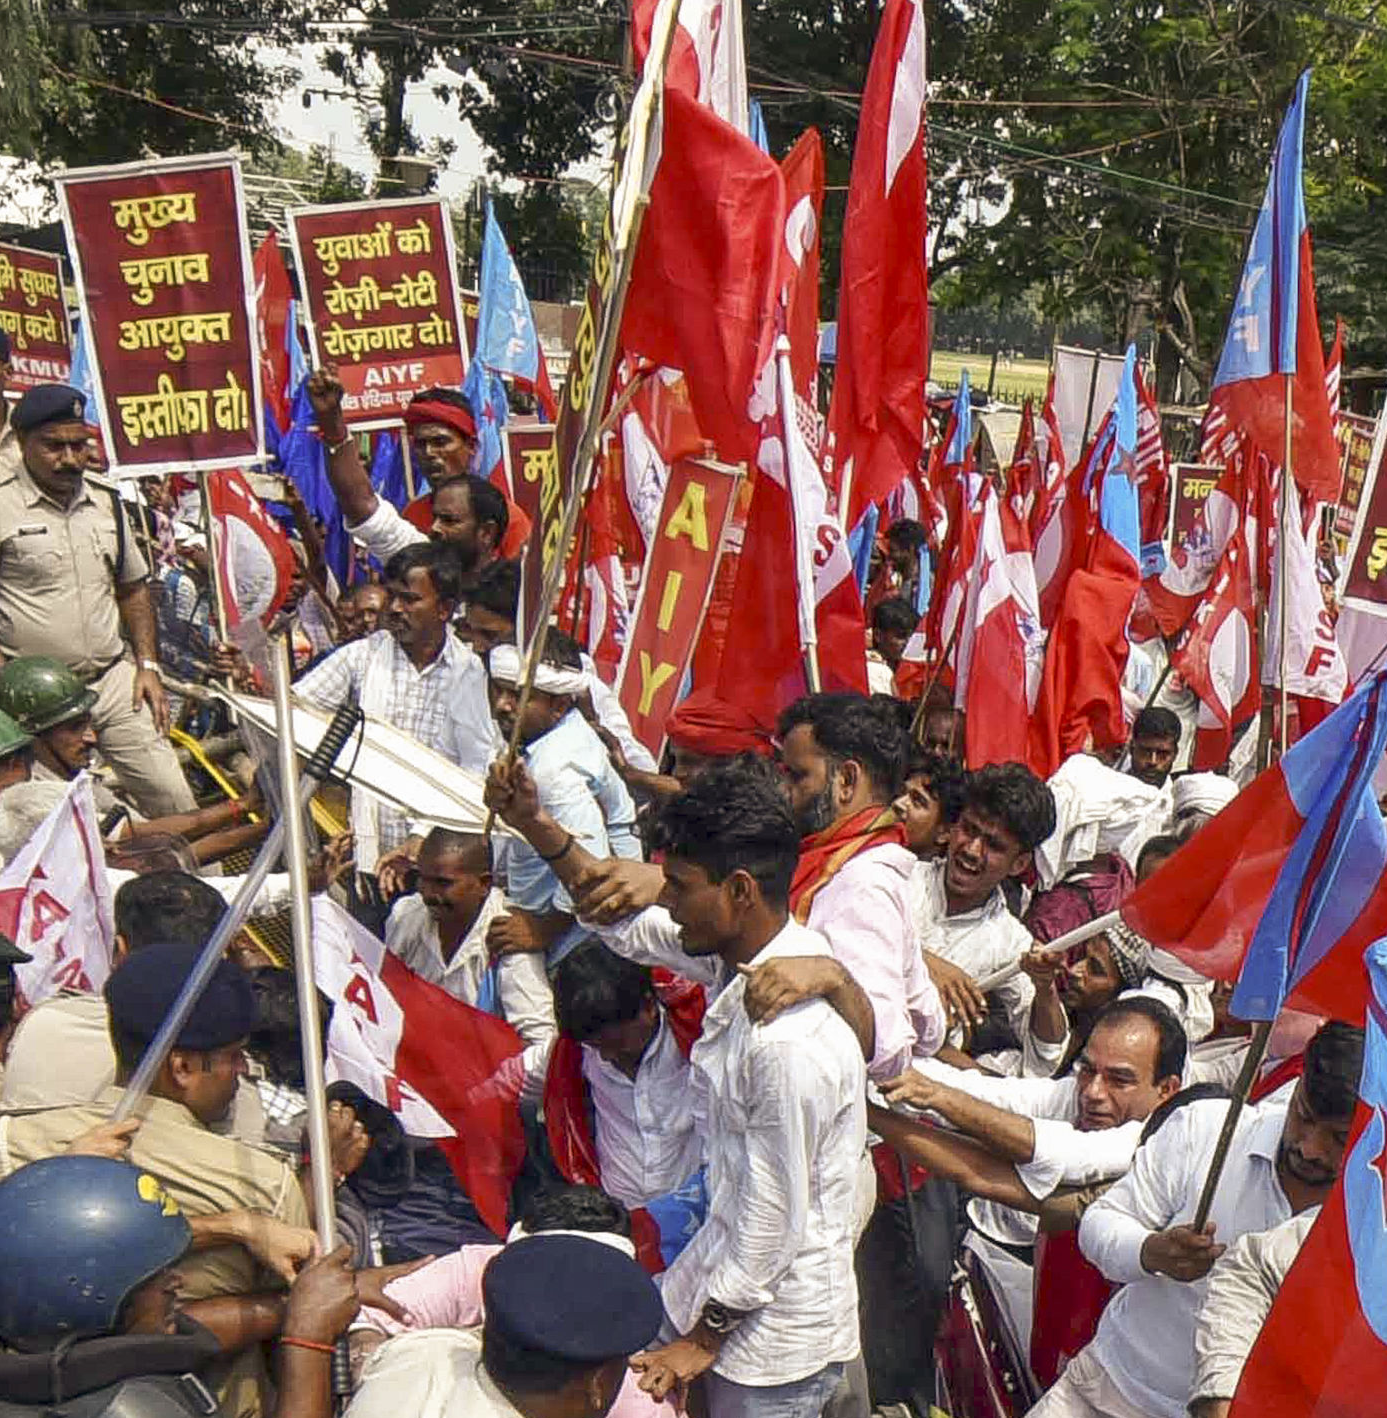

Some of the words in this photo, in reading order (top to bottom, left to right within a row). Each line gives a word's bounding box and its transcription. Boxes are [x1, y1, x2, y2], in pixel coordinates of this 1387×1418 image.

[110, 193, 196, 246] मुख्य
[313, 222, 392, 276] युवाओं
[395, 219, 431, 255] को
[17, 267, 59, 307] सुधार
[119, 253, 209, 306] चुनाव
[323, 271, 438, 321] रोज़ी-रोटी
[118, 312, 232, 361] आयुक्त
[322, 321, 415, 362] रोज़गार
[11, 354, 71, 380] KMU
[364, 362, 426, 388] AIYF
[212, 369, 250, 431] दो!
